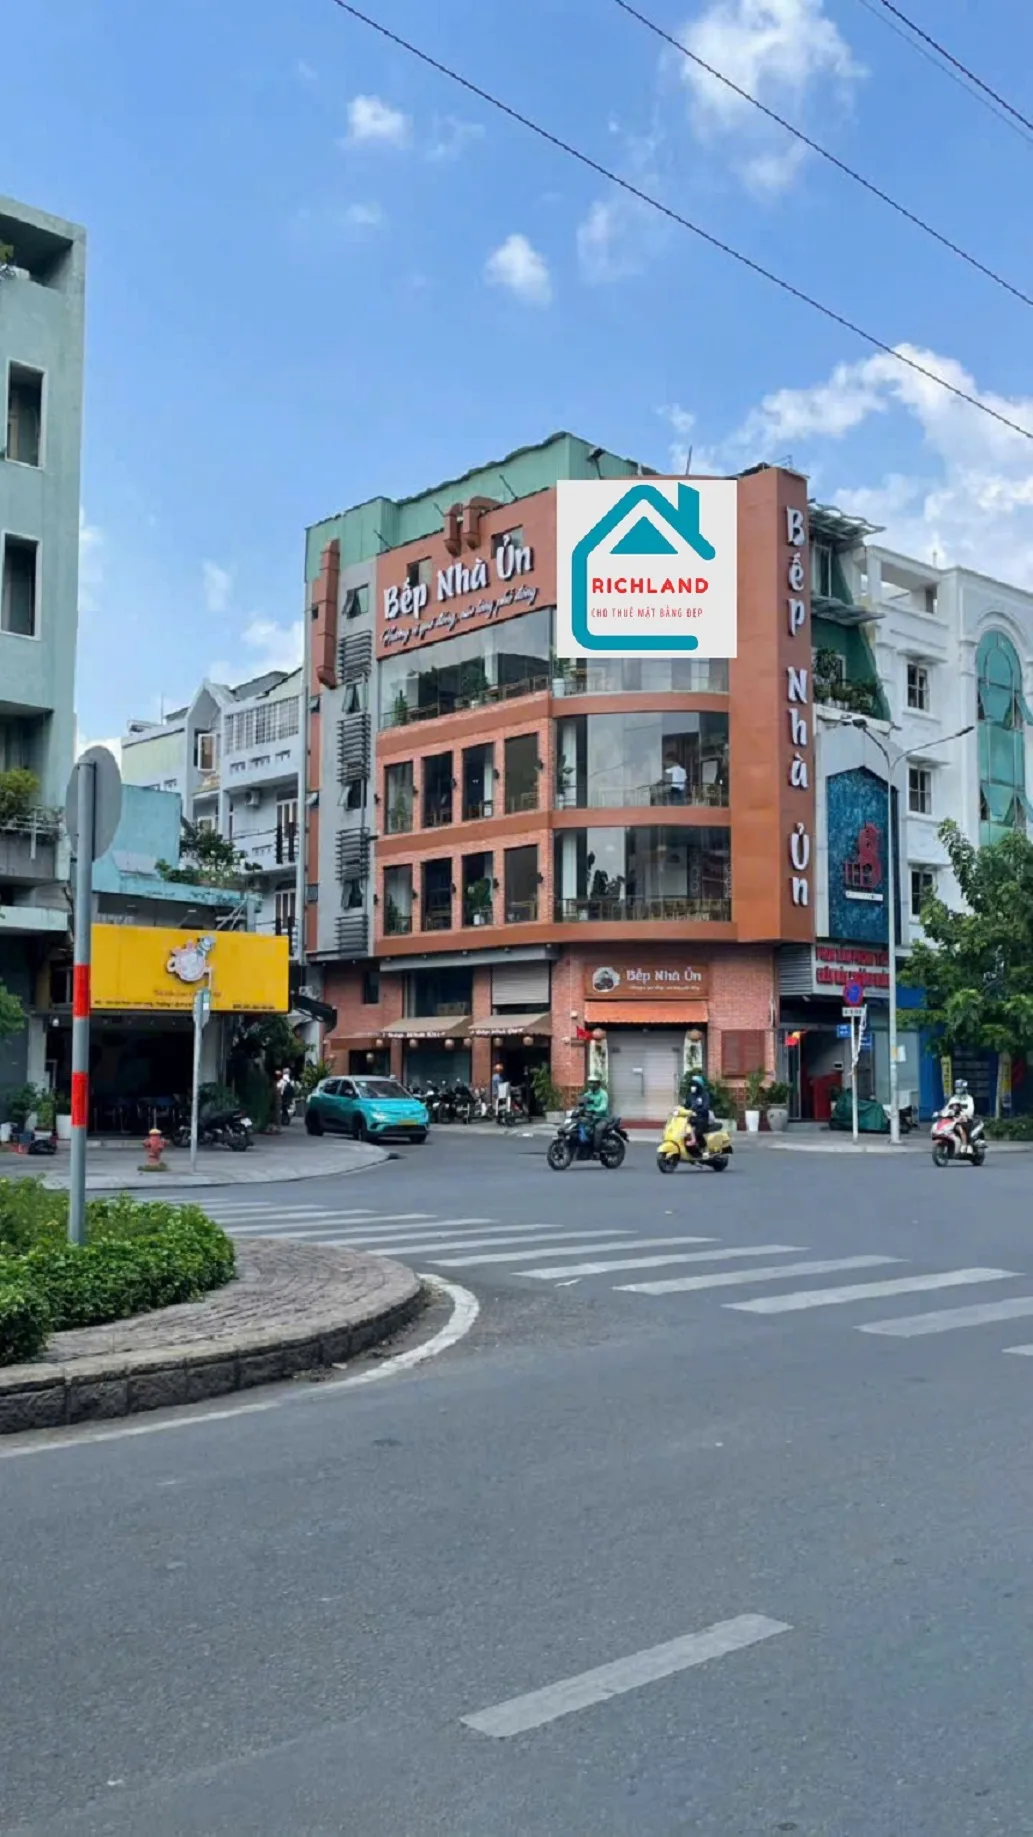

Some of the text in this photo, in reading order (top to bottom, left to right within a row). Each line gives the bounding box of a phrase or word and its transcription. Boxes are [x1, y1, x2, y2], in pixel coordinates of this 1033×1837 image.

[383, 534, 532, 620] Bếp Nhà Ủn
[786, 506, 810, 906] Bếp Nhà Ủn
[626, 967, 650, 985] Bếp
